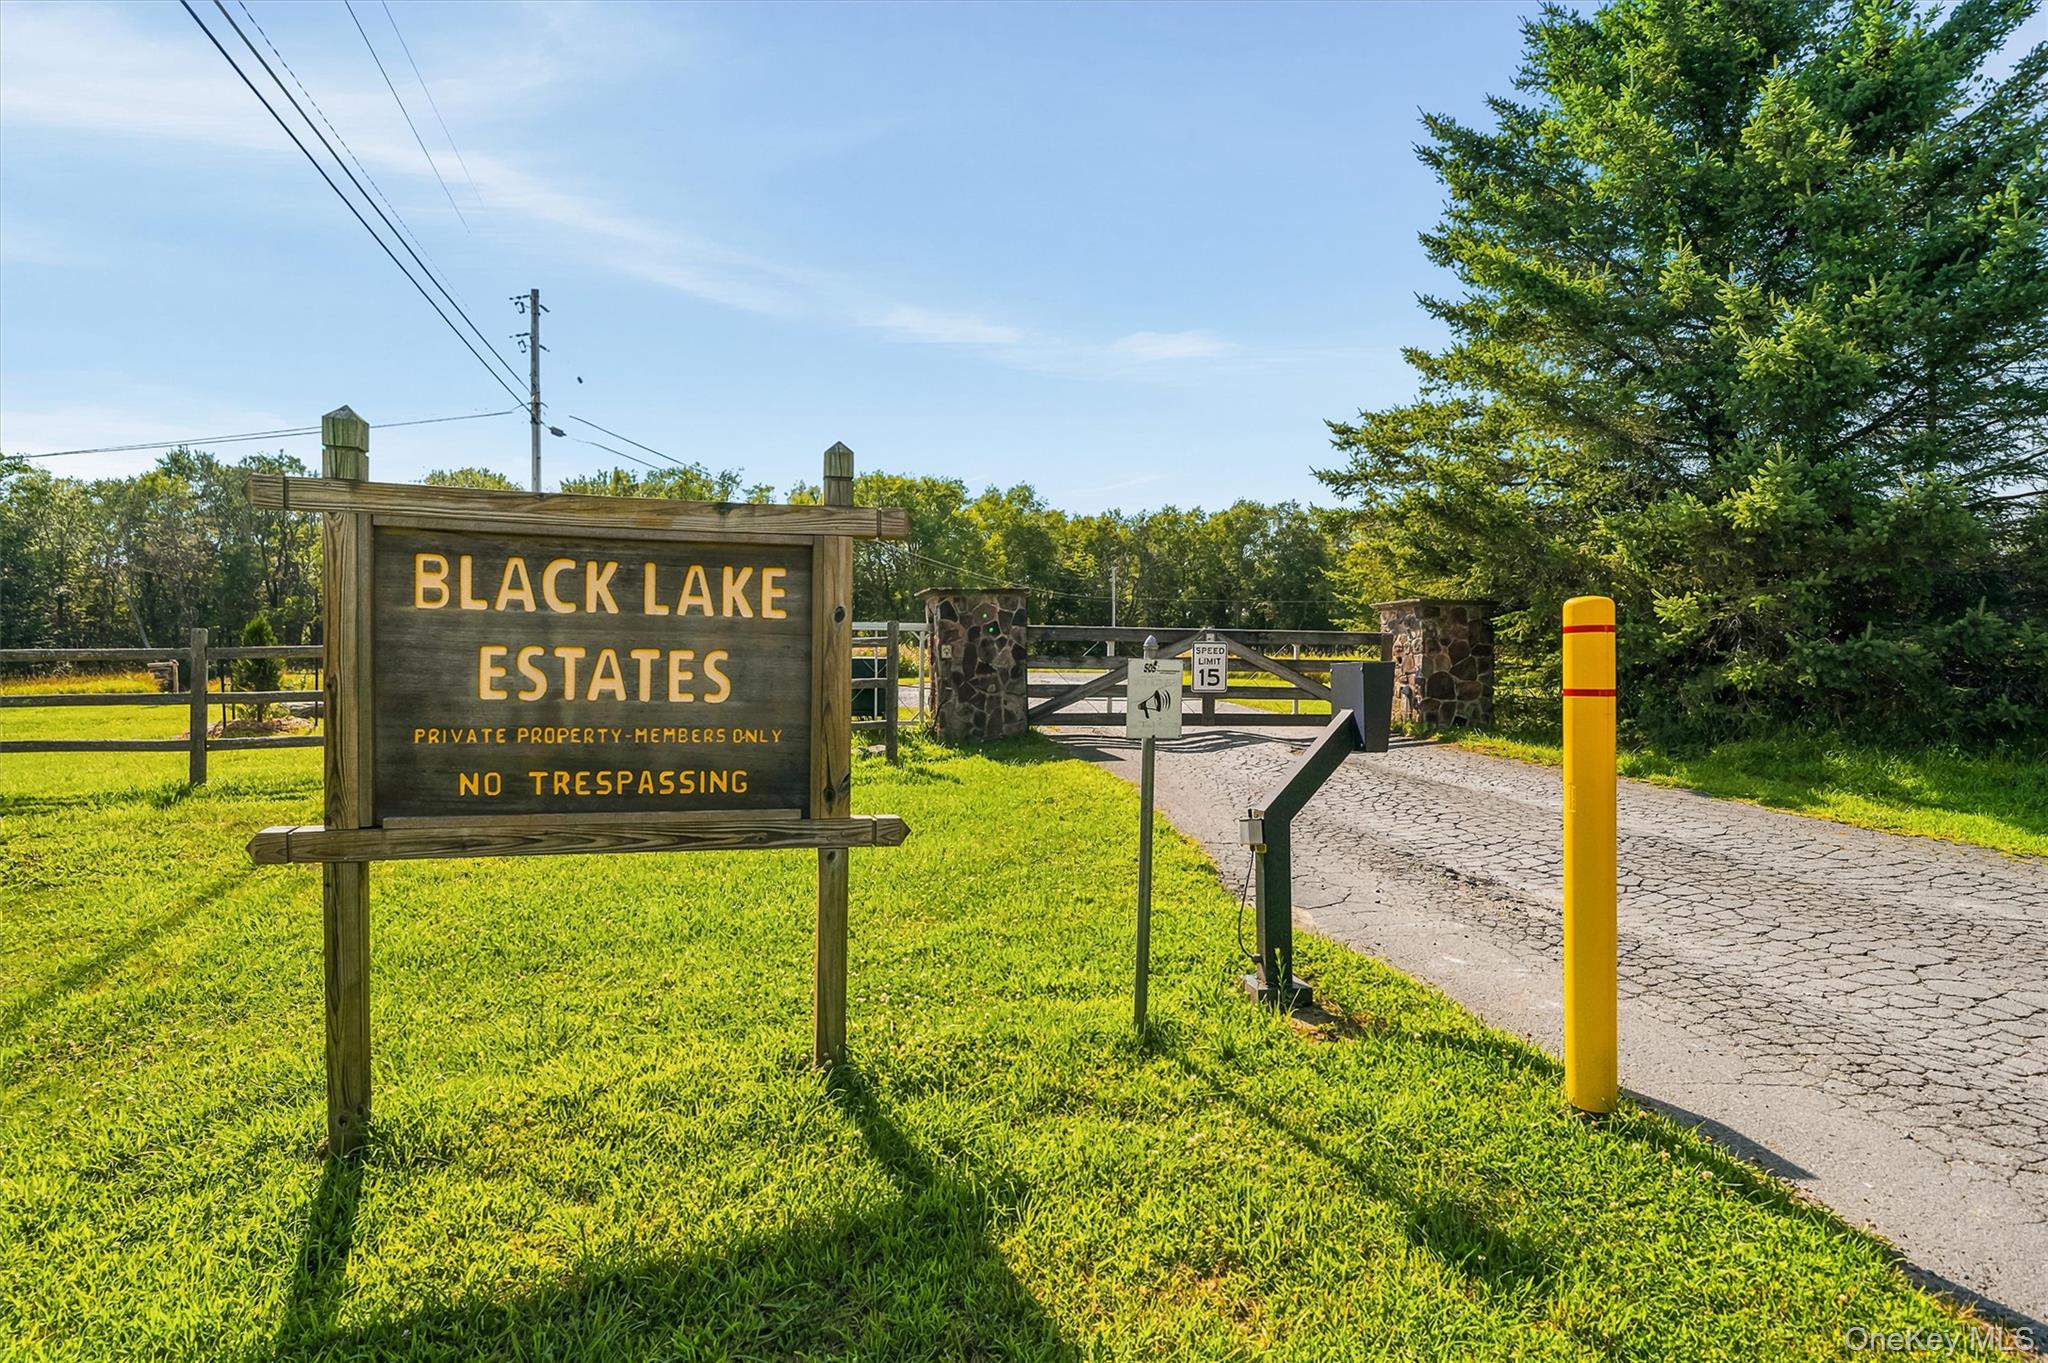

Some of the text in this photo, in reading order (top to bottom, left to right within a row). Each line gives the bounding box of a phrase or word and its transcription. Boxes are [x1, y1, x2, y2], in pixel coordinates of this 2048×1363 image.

[414, 552, 789, 620] BLACK LAKE
[1196, 647, 1225, 655] SPEED
[1198, 657, 1222, 666] LIMIT
[478, 645, 732, 704] ESTATES
[1199, 668, 1221, 687] 15
[414, 728, 507, 744] PRIVATE
[732, 729, 784, 744] ONLY
[458, 770, 748, 796] NO TRESPASSING
